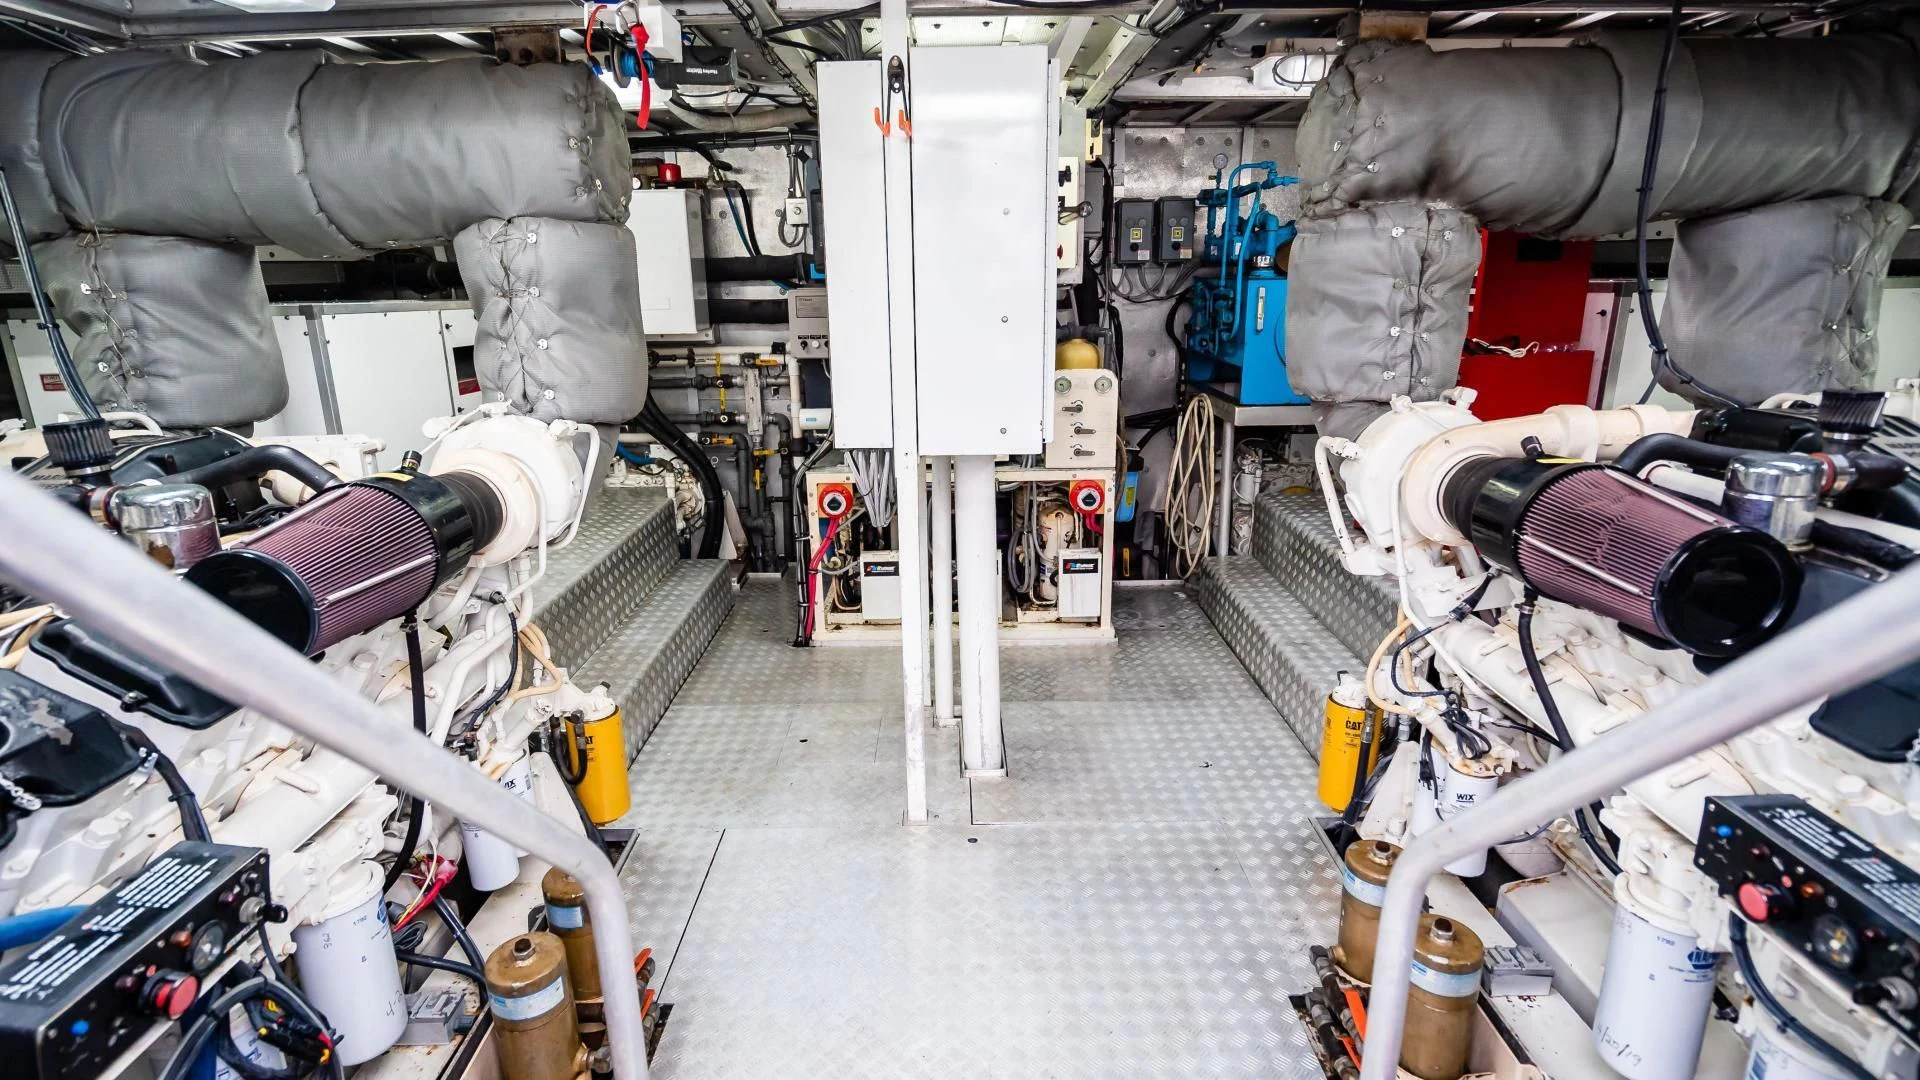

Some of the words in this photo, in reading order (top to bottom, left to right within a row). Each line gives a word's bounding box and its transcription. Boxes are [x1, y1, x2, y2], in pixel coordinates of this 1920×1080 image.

[1345, 720, 1363, 731] CAT
[585, 735, 594, 744] AT
[1456, 792, 1475, 801] WIX
